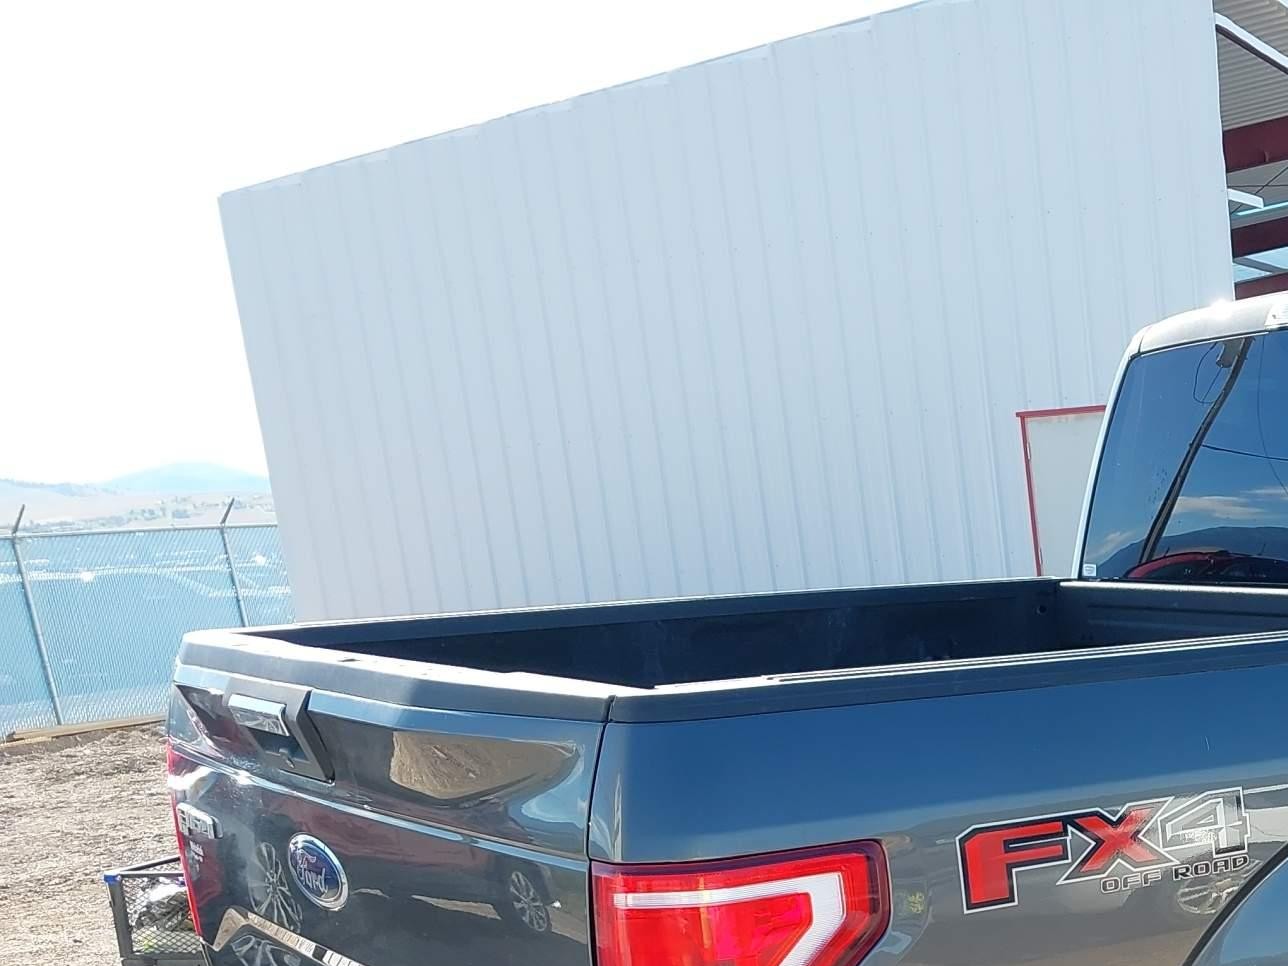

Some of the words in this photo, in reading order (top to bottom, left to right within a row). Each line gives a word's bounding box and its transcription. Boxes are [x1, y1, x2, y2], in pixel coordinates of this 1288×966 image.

[294, 847, 330, 894] Ford
[956, 786, 1250, 914] FX4
[1100, 869, 1162, 894] OFF
[1172, 853, 1249, 882] ROAD
